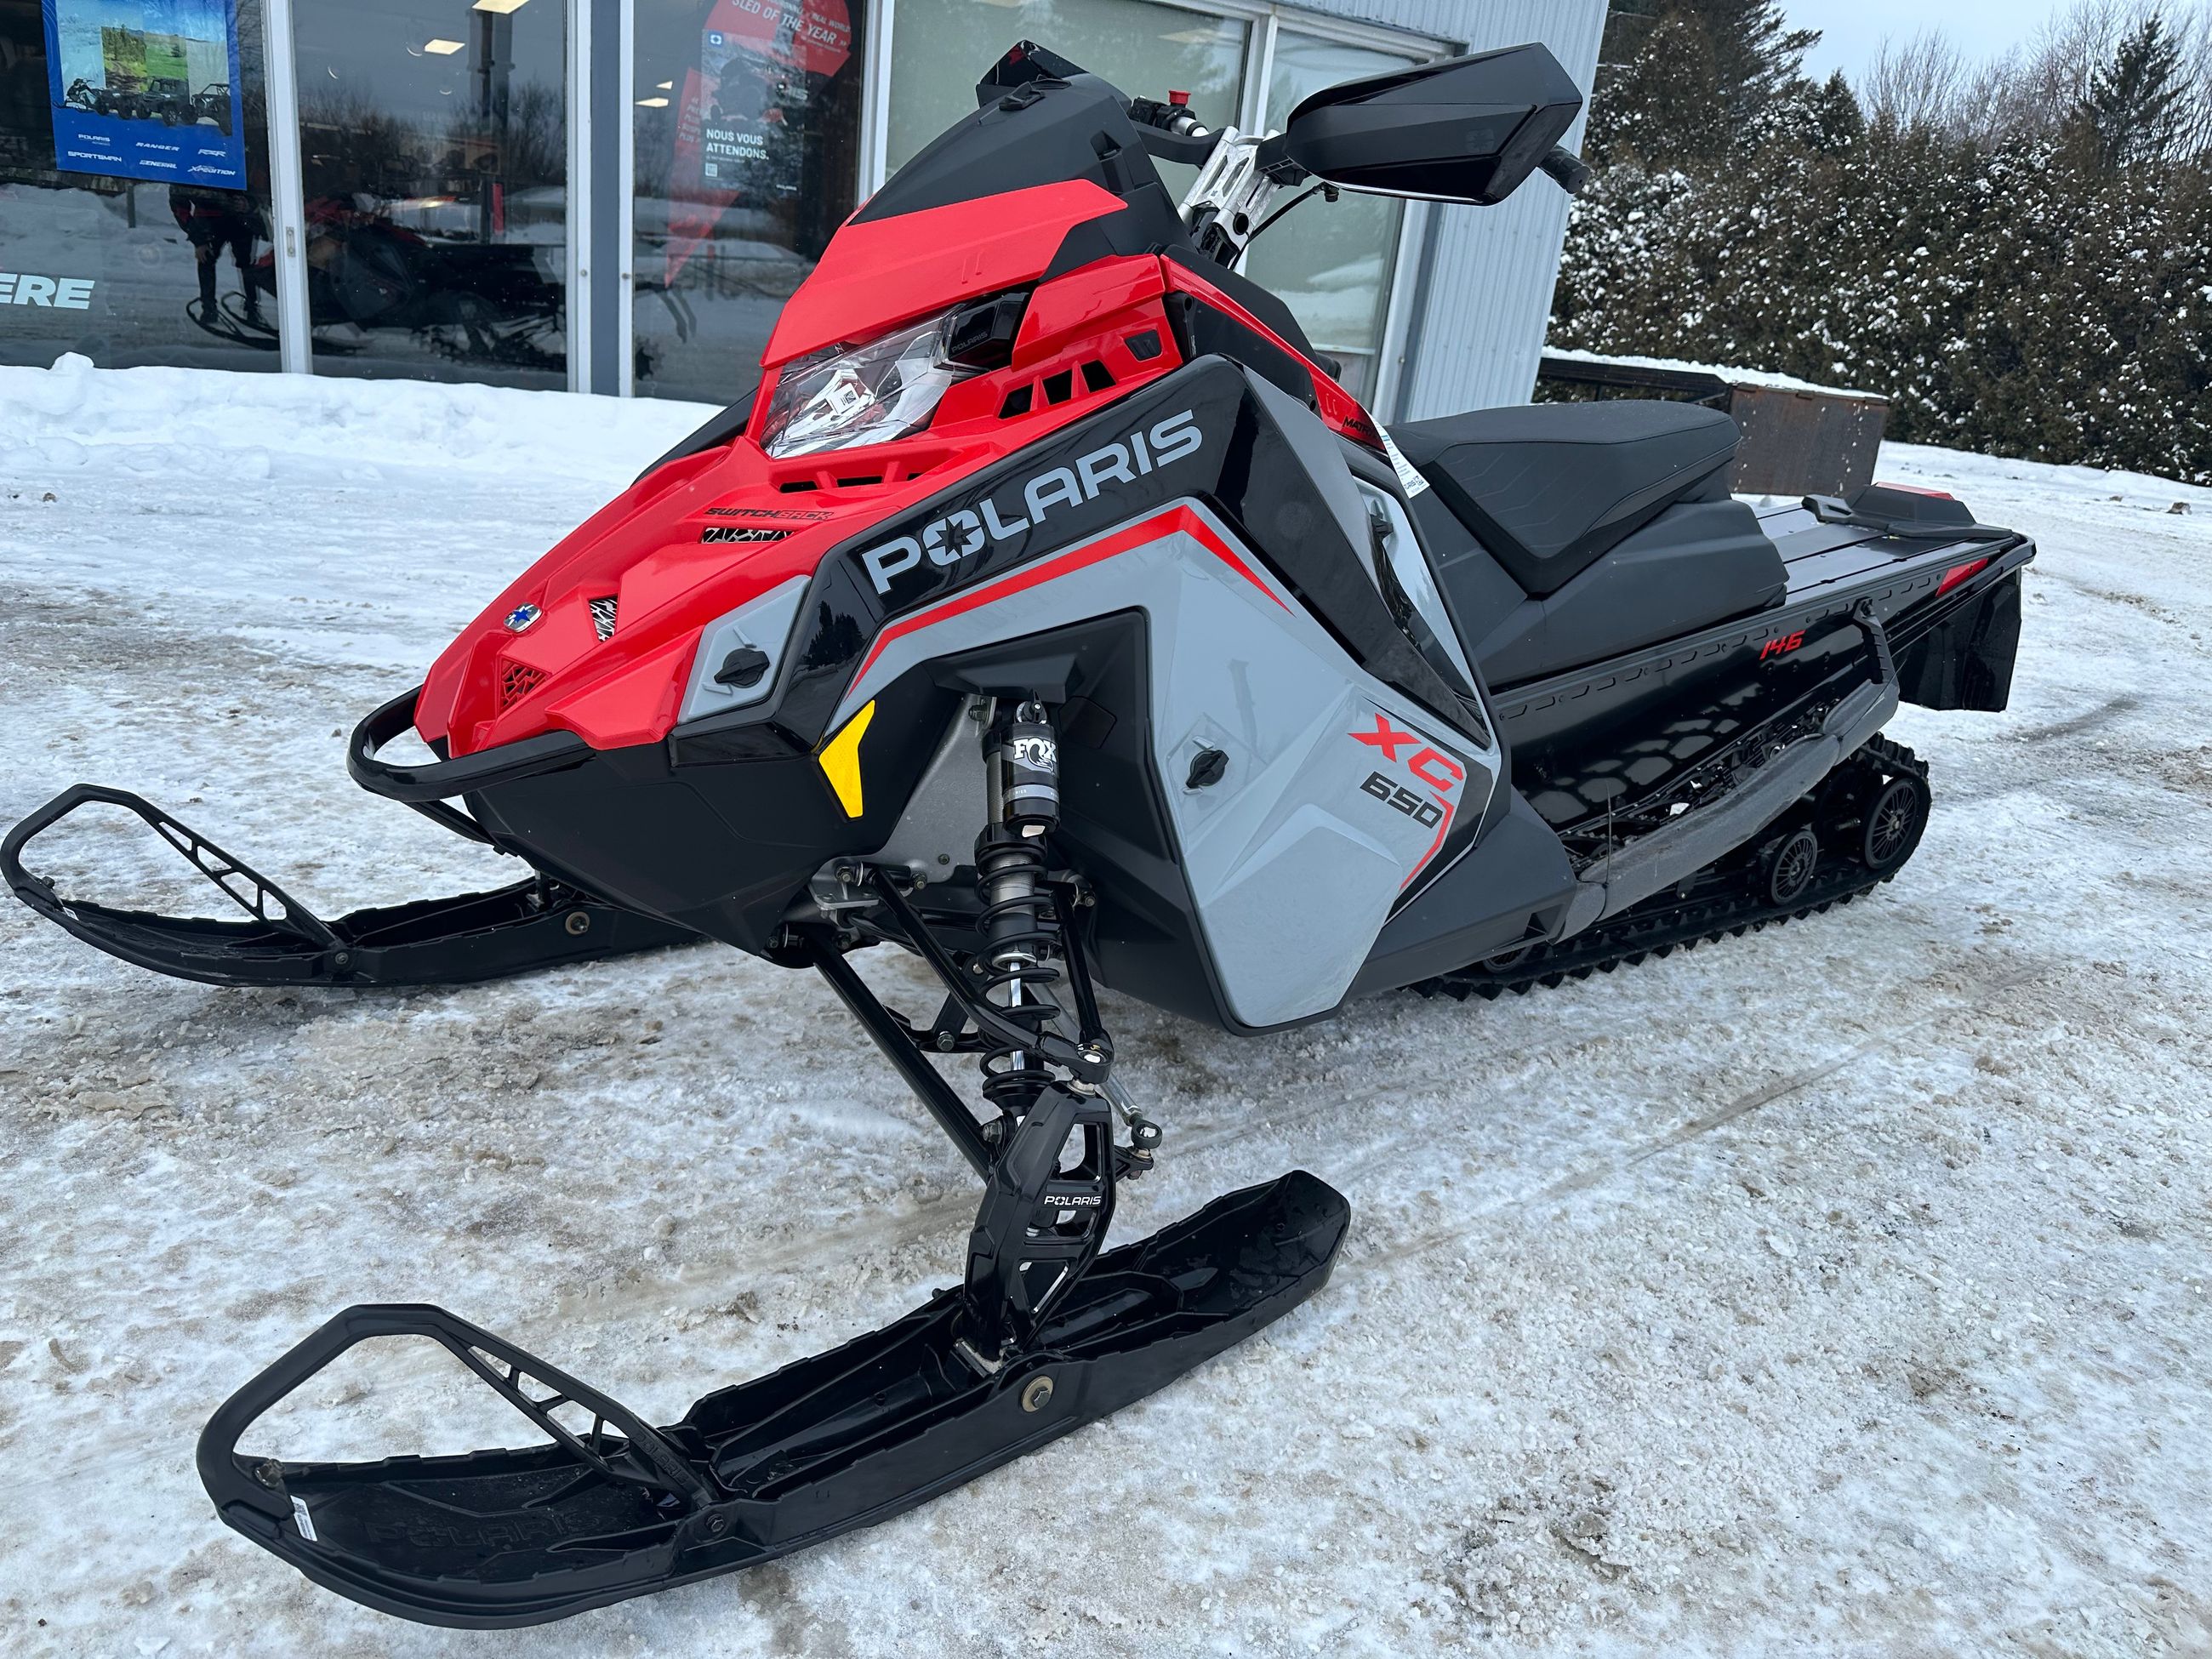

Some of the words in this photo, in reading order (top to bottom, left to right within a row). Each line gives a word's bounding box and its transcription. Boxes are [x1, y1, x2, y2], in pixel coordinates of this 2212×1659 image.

[762, 7, 780, 21] OF
[781, 13, 804, 32] THE
[807, 23, 837, 45] YEAR
[78, 134, 111, 142] POLARIS
[135, 142, 180, 151] RANGER
[705, 128, 735, 141] NOUS
[737, 134, 764, 146] VOUS
[67, 151, 122, 162] SPORTSMAN
[705, 142, 770, 161] ATTENDONS.
[861, 408, 1204, 596] POLARIS
[704, 507, 835, 522] SWITCHBACK
[1759, 630, 1806, 661] 146
[1013, 737, 1058, 767] FOX
[1348, 712, 1465, 794] XC
[1359, 770, 1445, 830] 650
[1044, 1195, 1101, 1206] POLARIS
